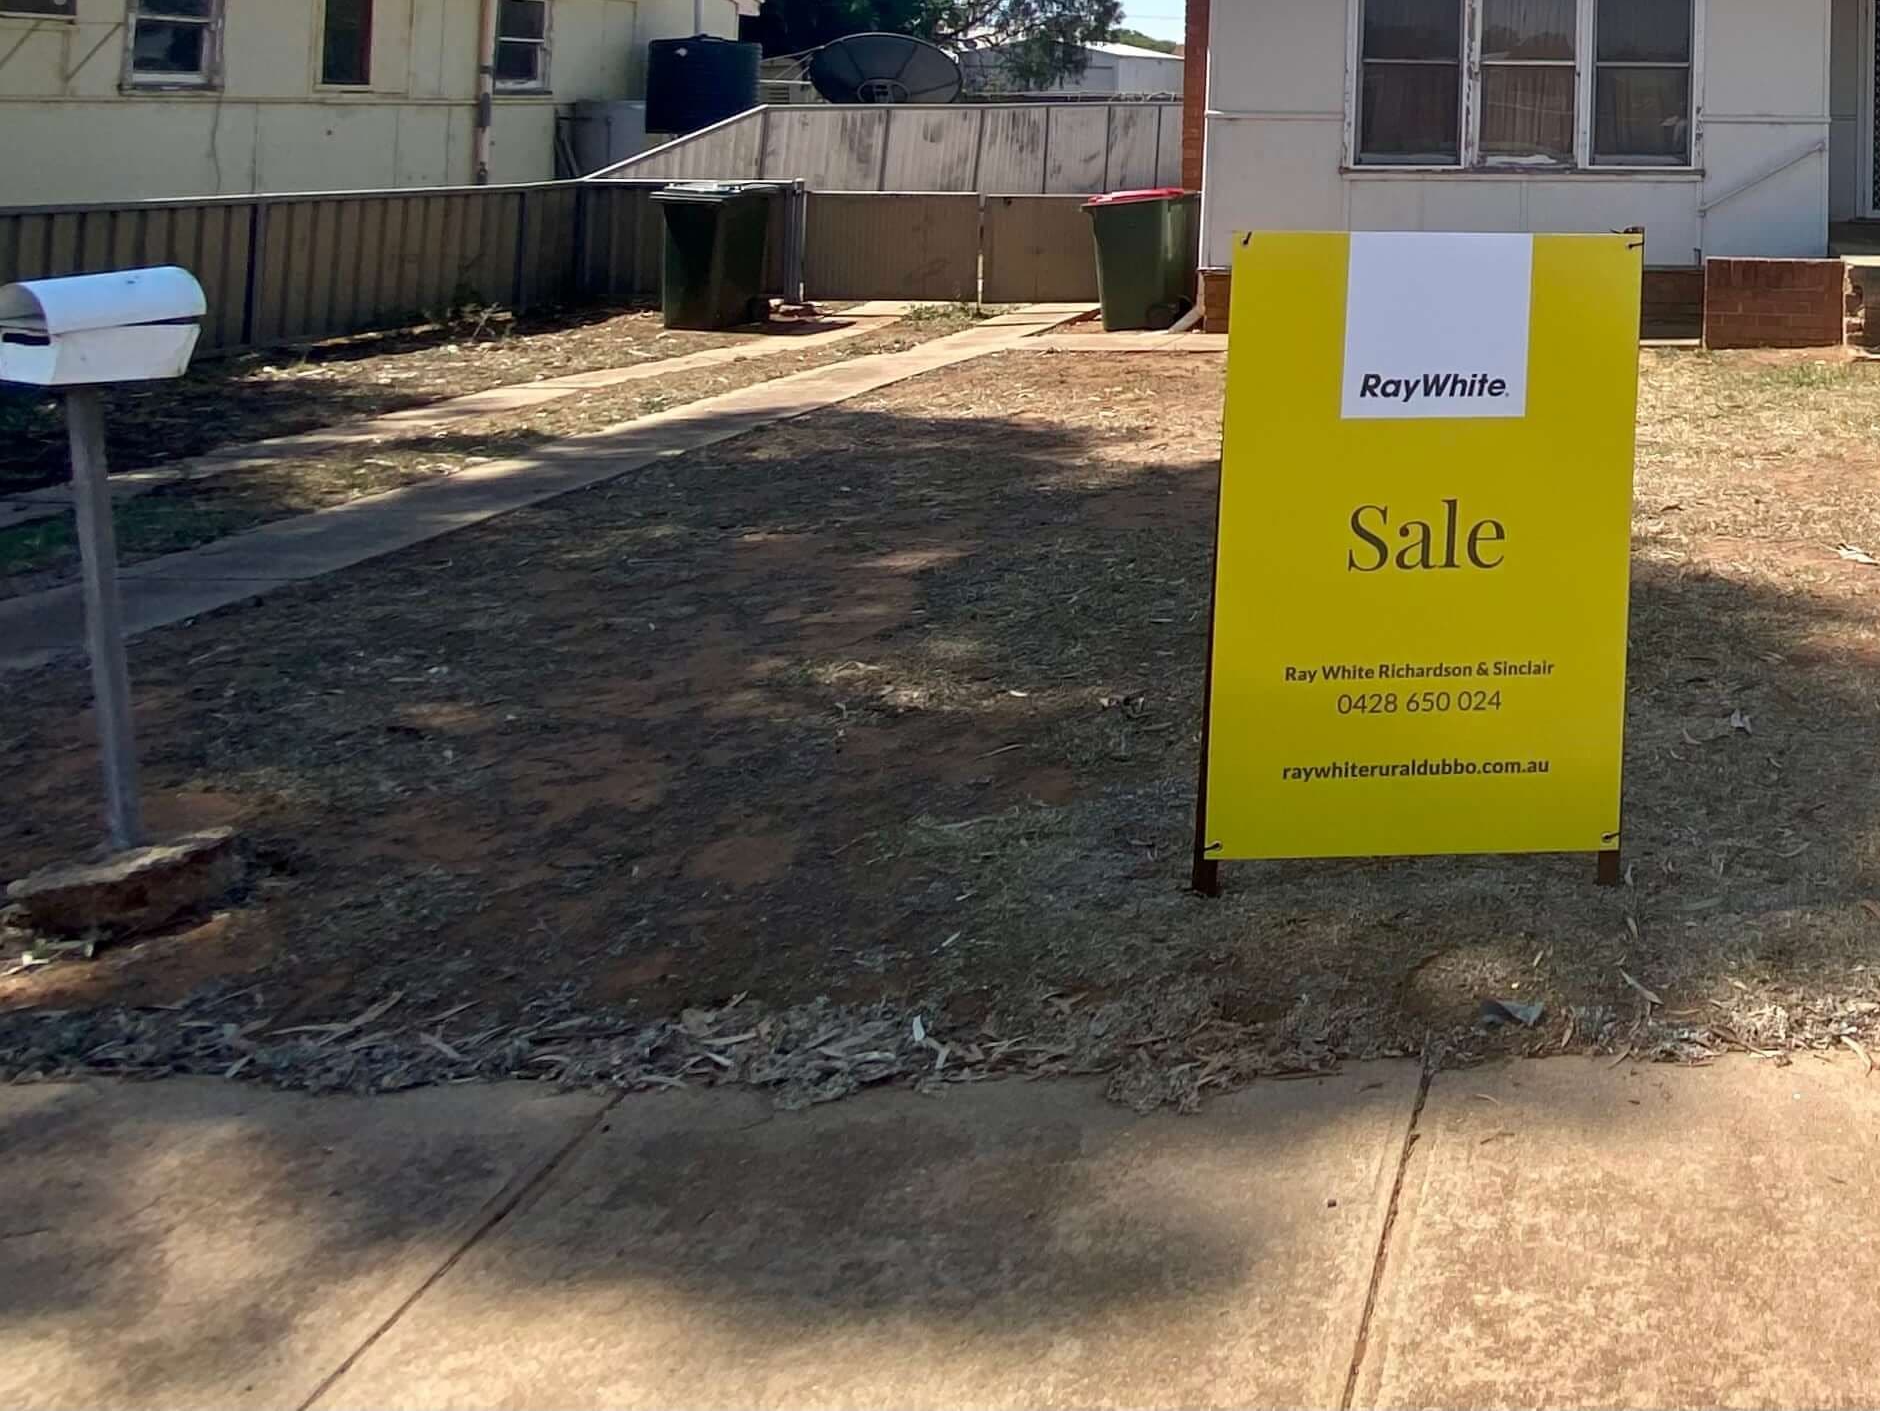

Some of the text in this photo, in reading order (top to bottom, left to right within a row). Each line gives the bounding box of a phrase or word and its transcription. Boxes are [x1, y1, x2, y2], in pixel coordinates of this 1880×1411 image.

[1347, 498, 1506, 572] Sale
[1284, 659, 1556, 684] Ray White Richardson & Sinclair
[1336, 689, 1503, 715] 0428 650 024
[1281, 758, 1550, 783] raywhiteruraldubbo.com.au
